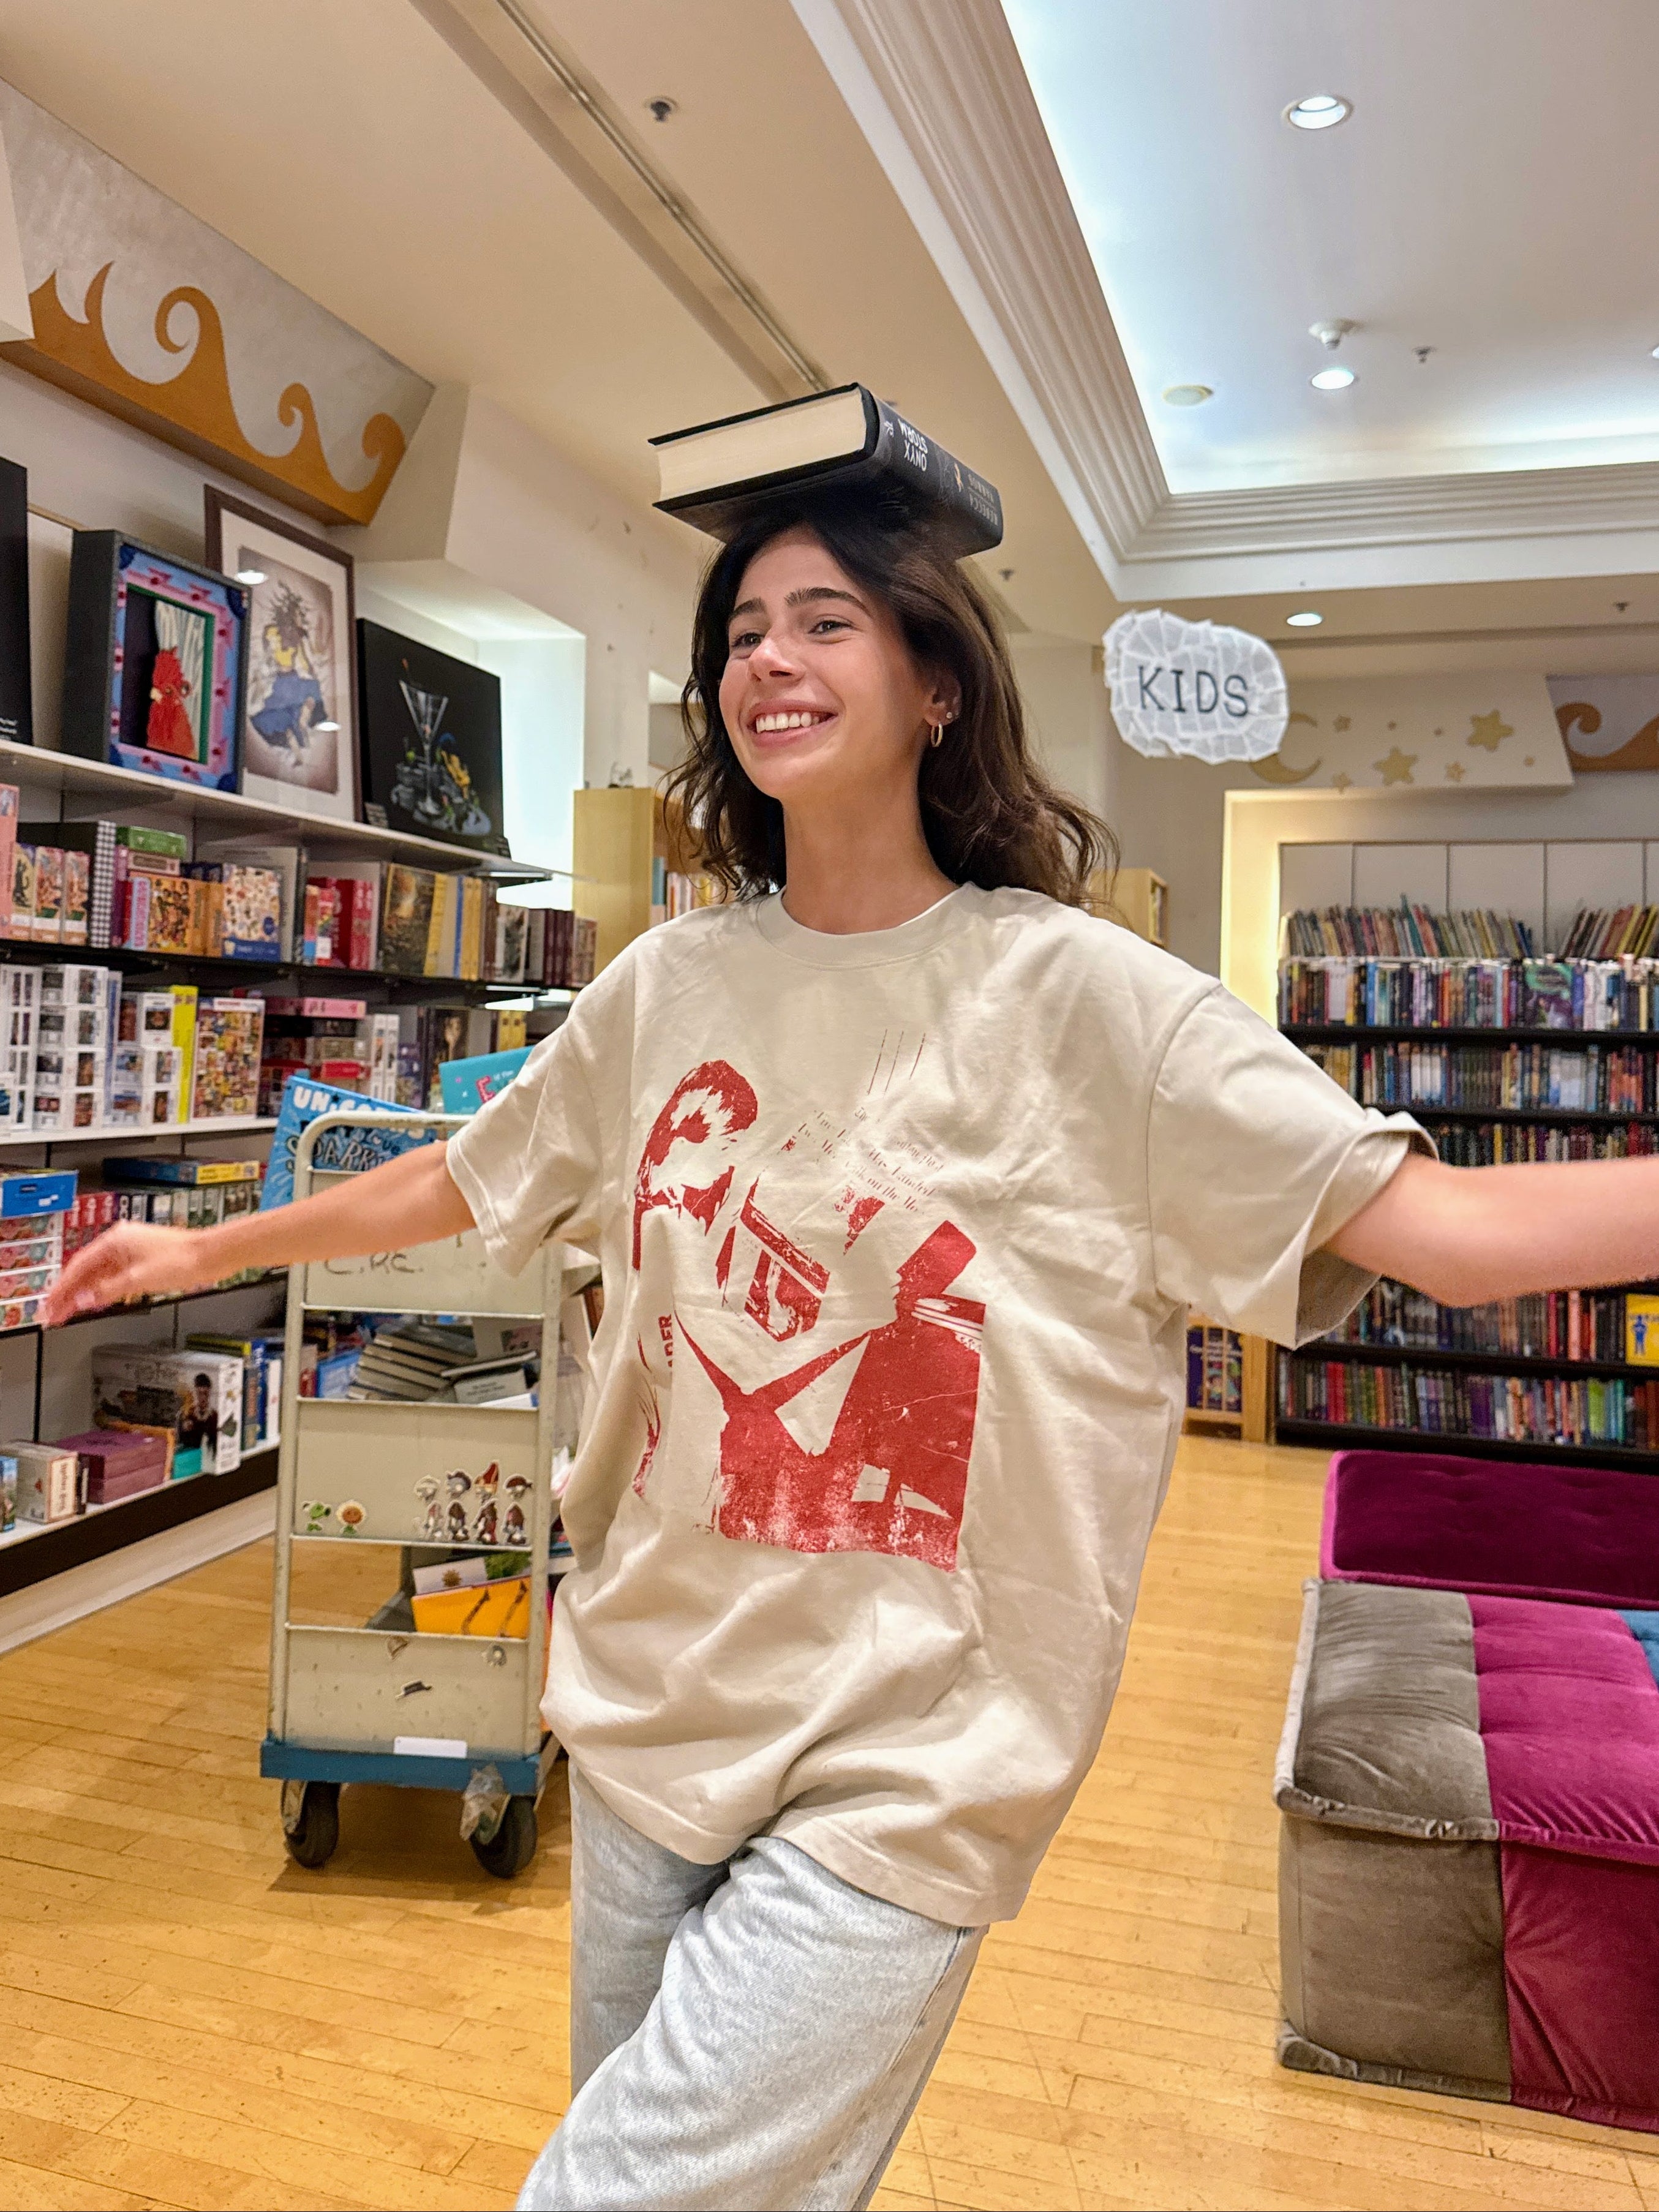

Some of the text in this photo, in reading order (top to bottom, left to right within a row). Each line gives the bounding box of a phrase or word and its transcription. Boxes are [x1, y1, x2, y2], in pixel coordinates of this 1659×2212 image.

[898, 418, 928, 454] STORM
[904, 440, 927, 472] ONYX
[1138, 666, 1249, 717] KIDS
